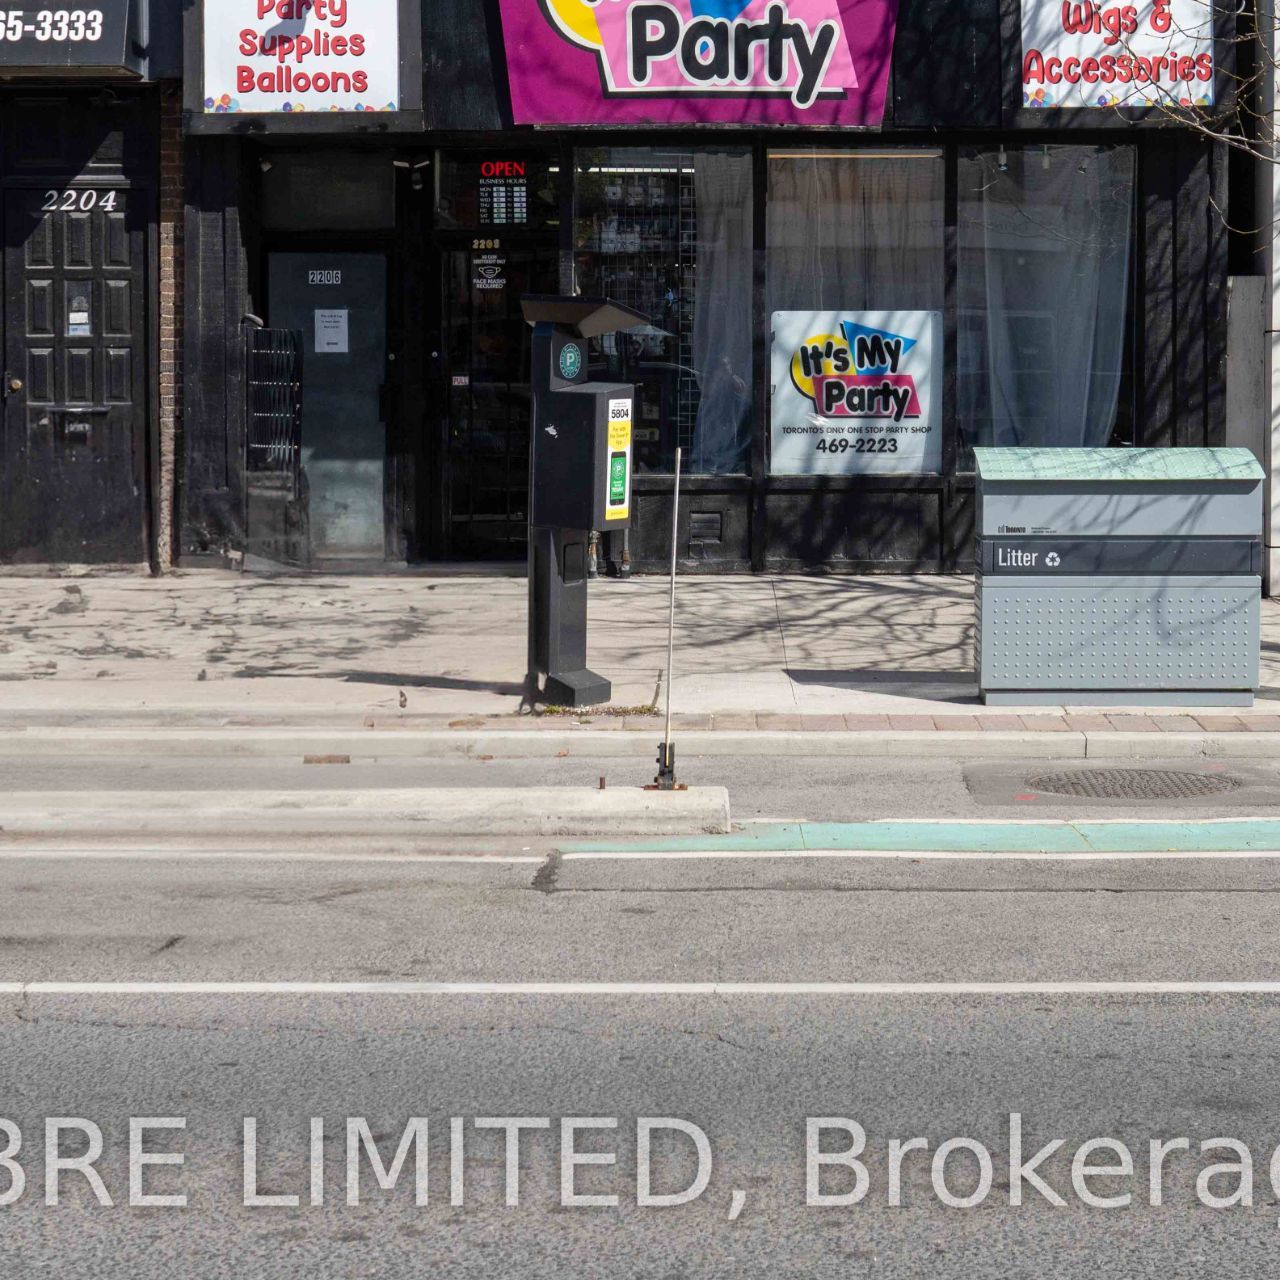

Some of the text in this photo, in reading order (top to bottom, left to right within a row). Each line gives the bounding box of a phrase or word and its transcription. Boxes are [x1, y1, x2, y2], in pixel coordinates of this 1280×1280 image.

[1061, 0, 1138, 46] Wigs
[238, 28, 366, 64] Supplies
[630, 4, 836, 105] Party
[1023, 48, 1213, 85] Accessories
[236, 65, 369, 93] Balloons
[480, 161, 525, 177] OPEN
[41, 190, 116, 211] 2204
[309, 271, 341, 284] 2206
[800, 335, 902, 377] It's My
[825, 380, 910, 422] Party
[611, 409, 629, 418] 5804
[782, 426, 932, 434] TORONTO'S ONLY ONE STOP PARTY SHOP
[816, 438, 898, 453] 469-2223
[999, 548, 1038, 566] Litter
